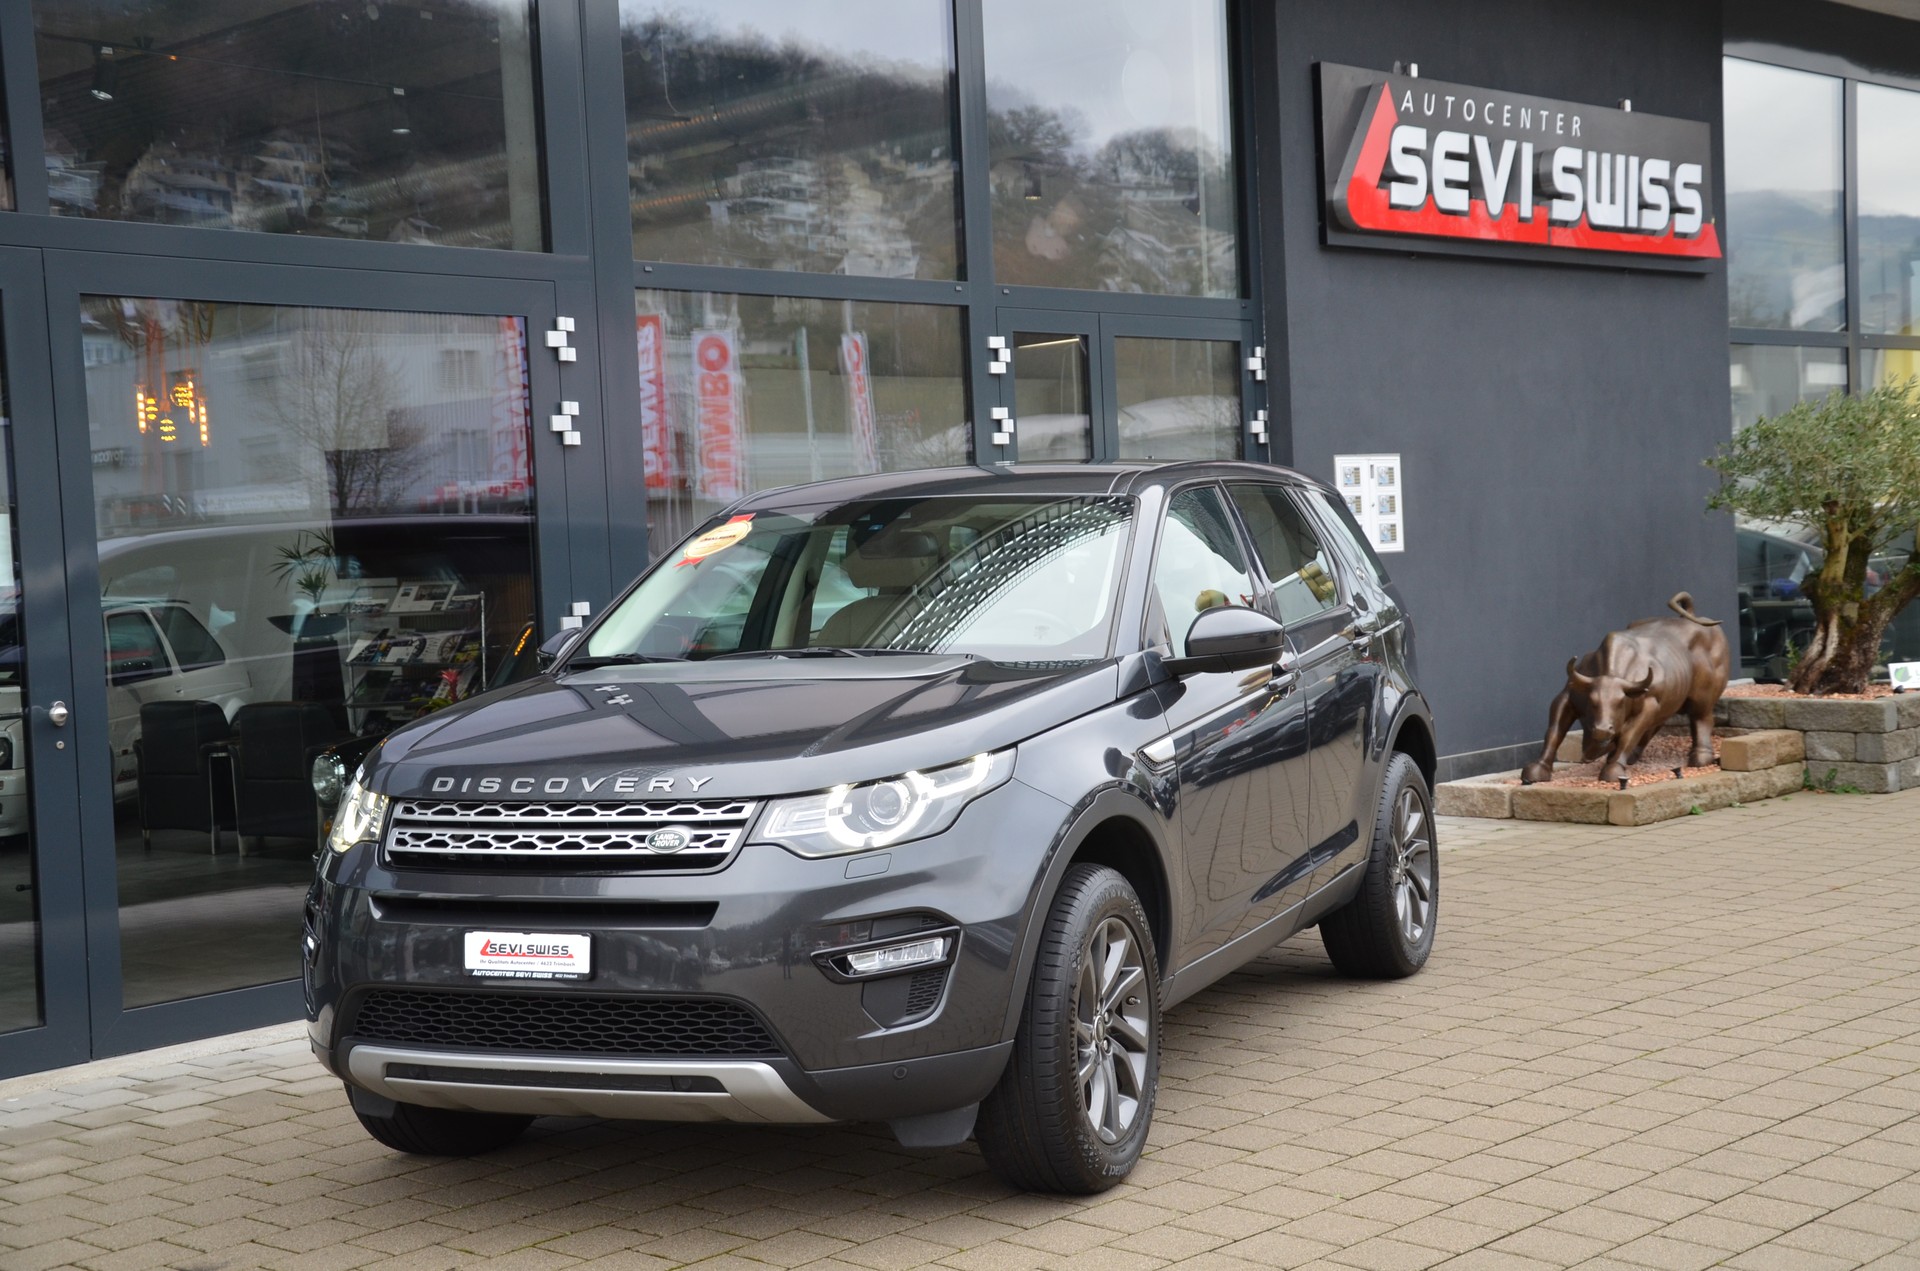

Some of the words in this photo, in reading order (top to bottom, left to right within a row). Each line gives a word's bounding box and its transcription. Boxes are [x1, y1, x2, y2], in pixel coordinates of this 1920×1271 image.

[1400, 88, 1582, 137] AUTOCENTER
[1388, 125, 1534, 221] SEVI
[1551, 145, 1702, 236] SWISS
[432, 776, 713, 793] DISCOVERY
[654, 833, 675, 841] LAND
[489, 943, 522, 954] SEVI
[526, 944, 569, 956] SWISS
